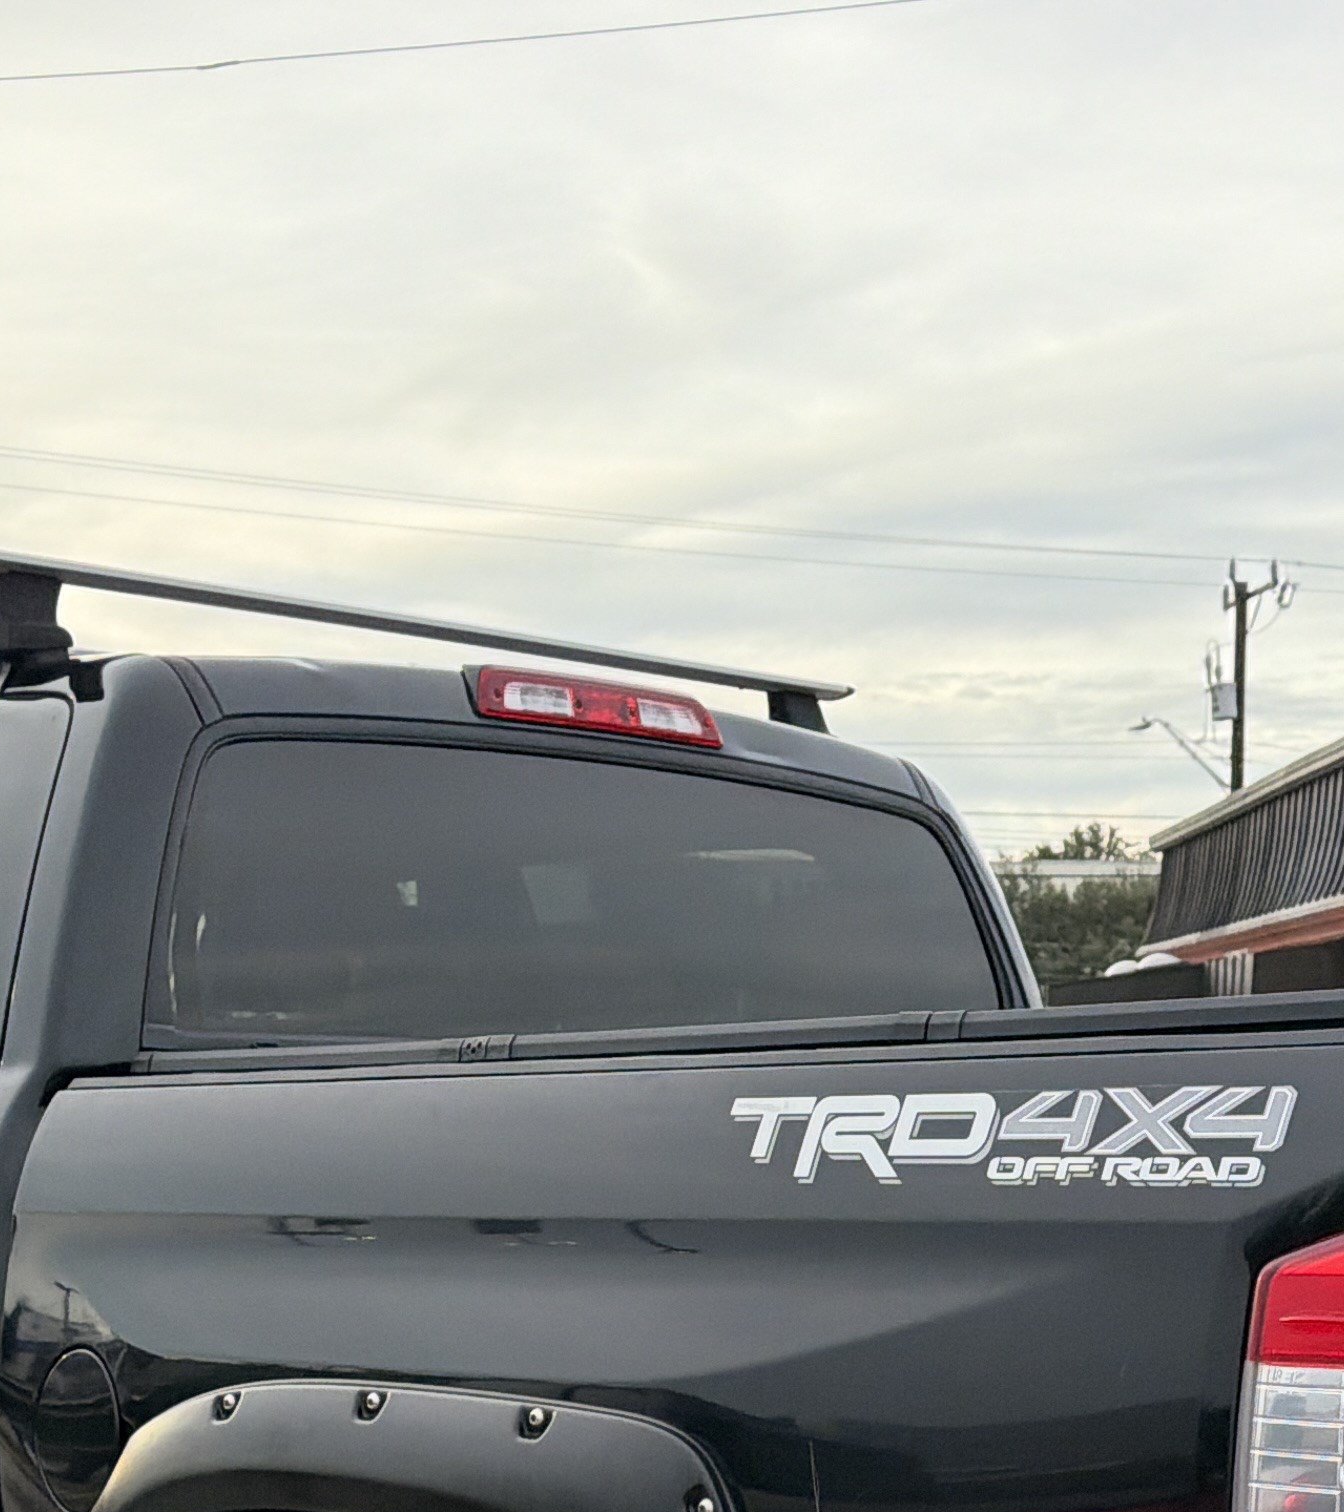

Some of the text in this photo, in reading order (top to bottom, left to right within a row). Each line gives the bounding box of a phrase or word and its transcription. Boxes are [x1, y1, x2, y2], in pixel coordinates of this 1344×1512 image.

[730, 1091, 1000, 1185] TRD
[987, 1156, 1266, 1188] OFF ROAD
